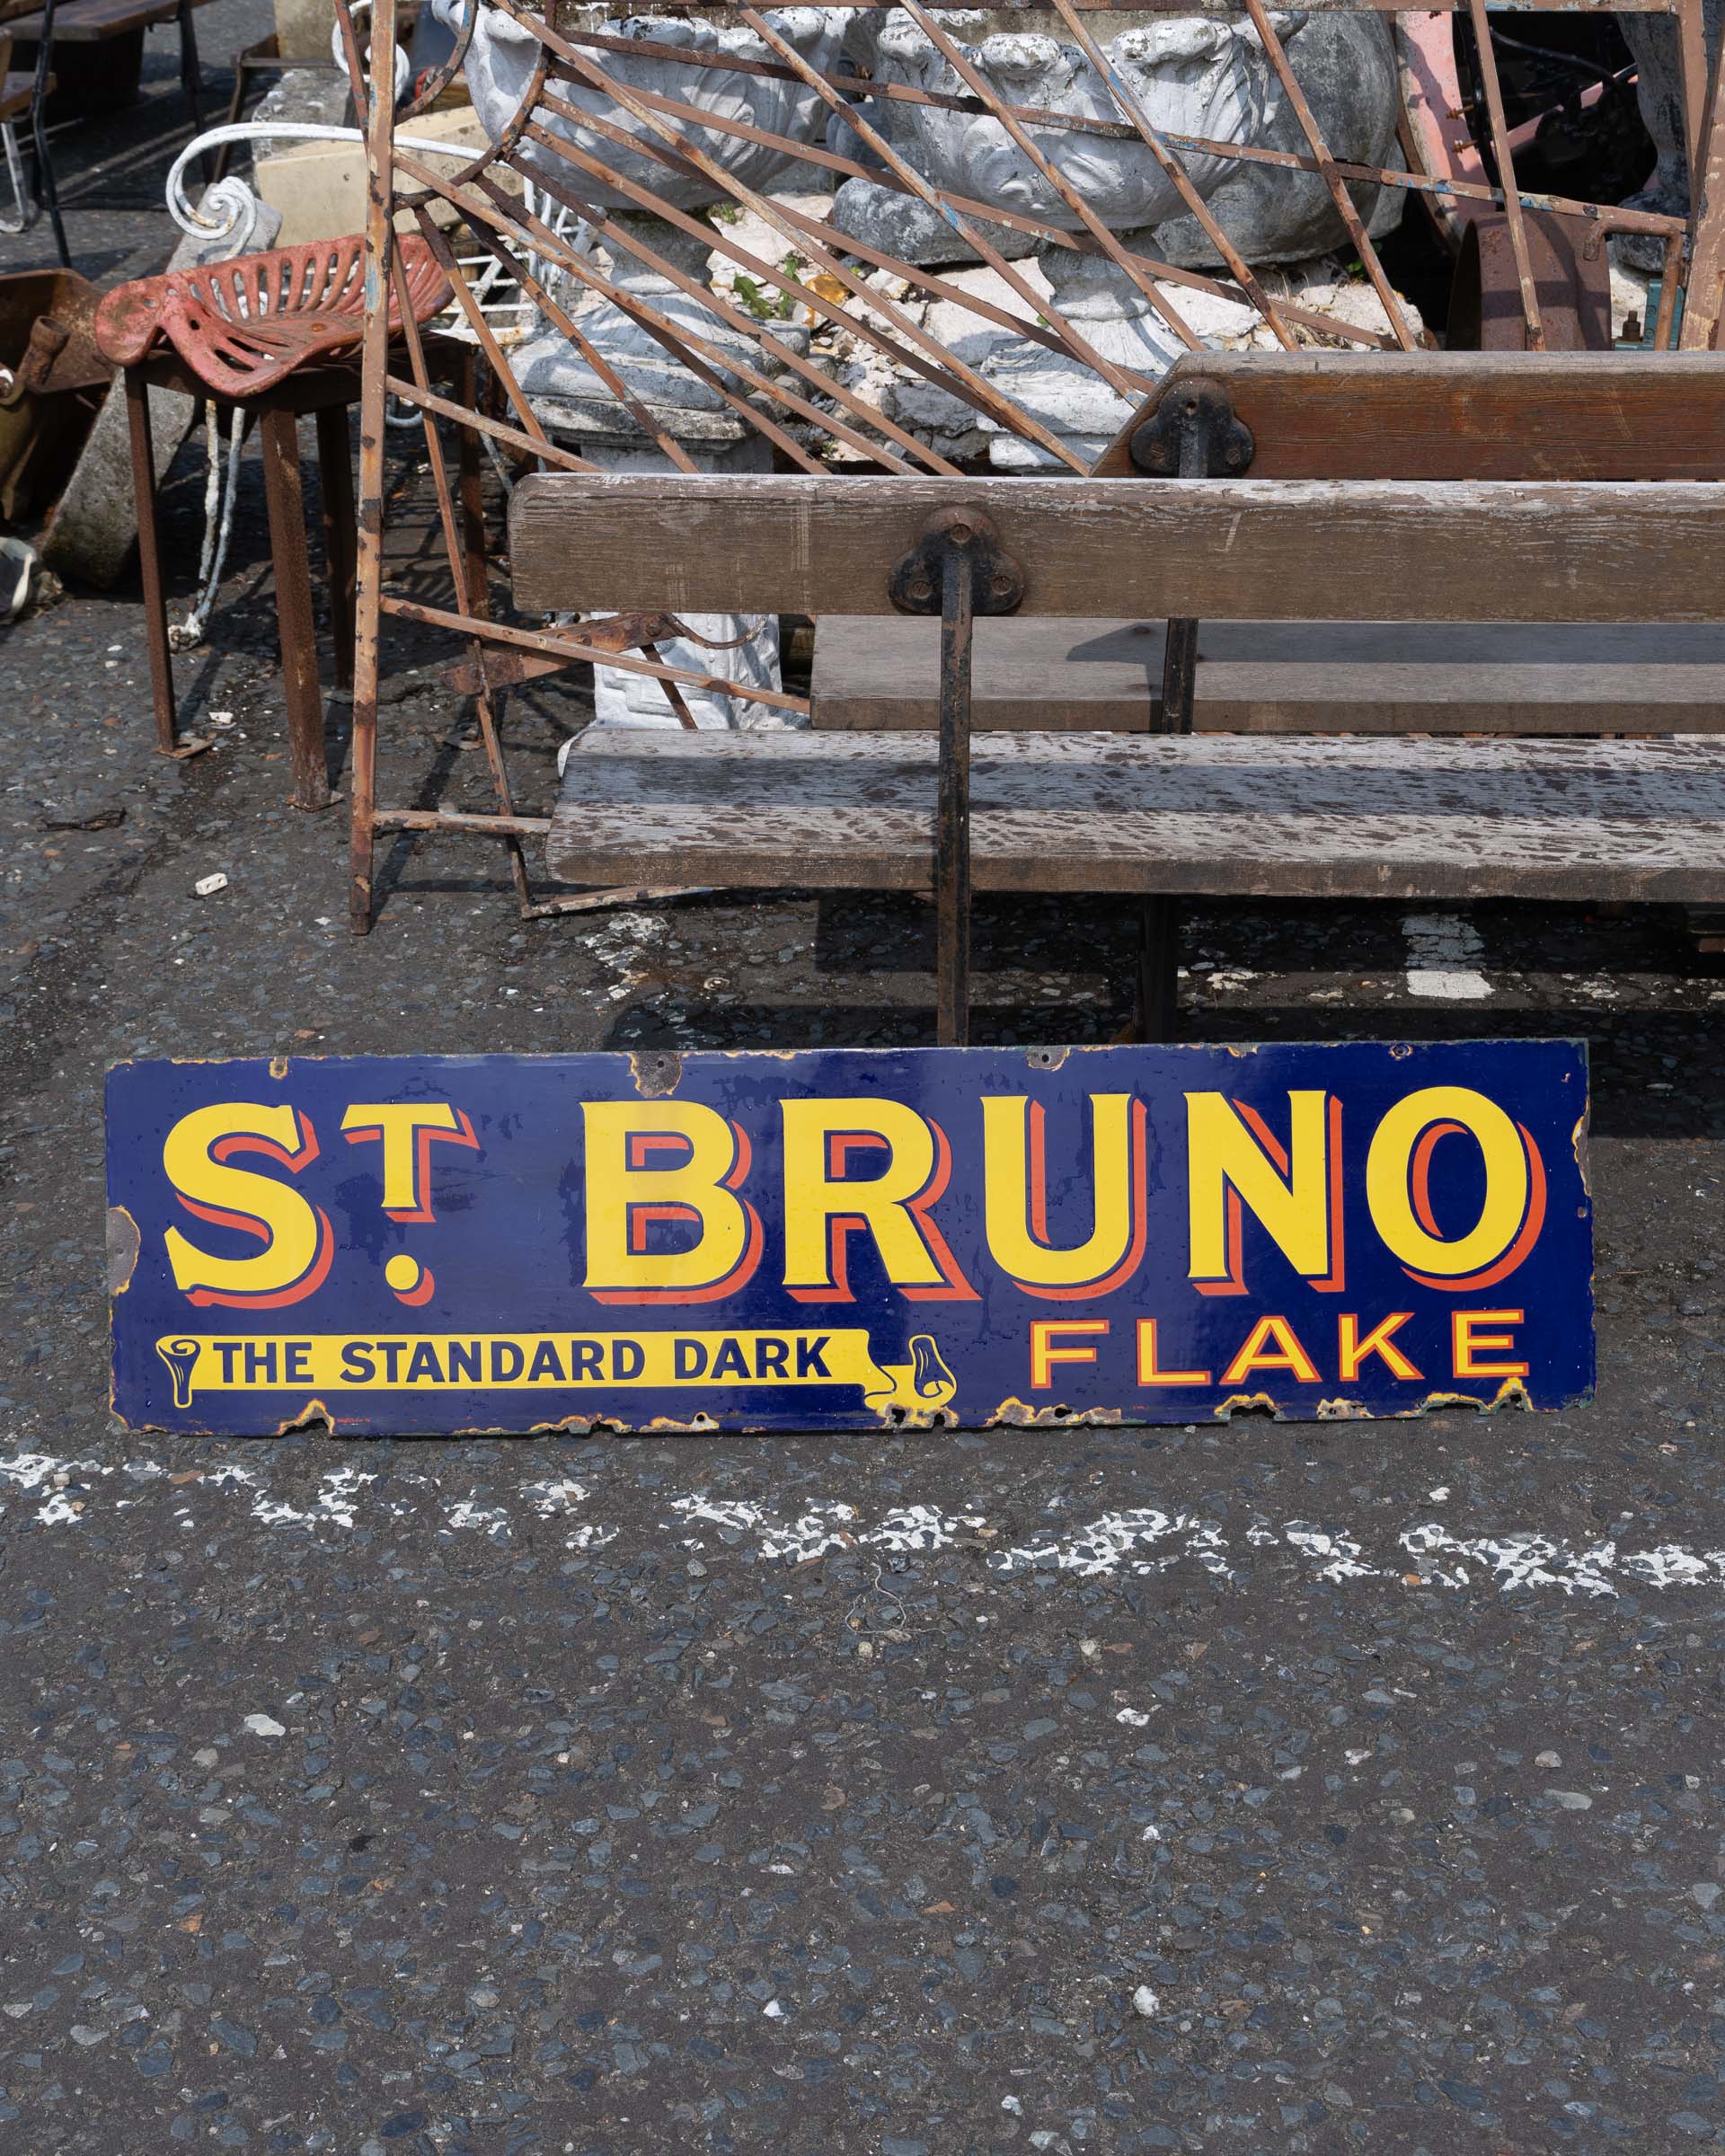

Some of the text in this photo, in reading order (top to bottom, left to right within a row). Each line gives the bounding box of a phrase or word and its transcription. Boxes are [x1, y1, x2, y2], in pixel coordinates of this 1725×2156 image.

[579, 1085, 1548, 1306] BRUNO
[212, 1336, 834, 1384] THE STANDARD DARK
[1029, 1308, 1527, 1391] FLAKE
